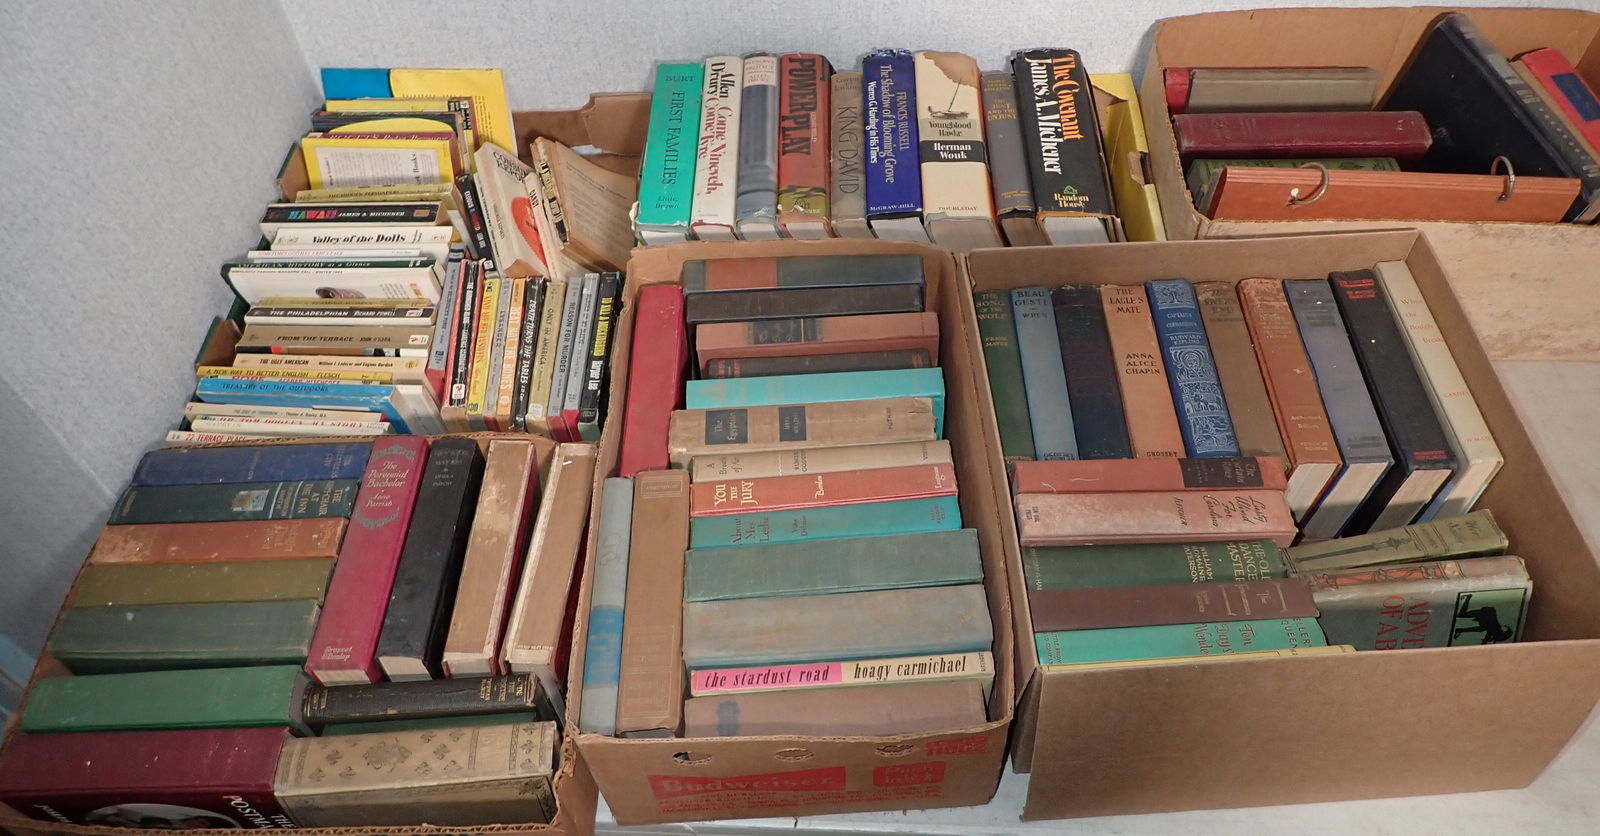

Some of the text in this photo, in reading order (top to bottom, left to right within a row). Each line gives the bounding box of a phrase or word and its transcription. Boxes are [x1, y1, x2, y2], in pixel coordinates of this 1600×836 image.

[707, 62, 726, 96] Drury
[719, 72, 735, 98] Allen
[782, 57, 818, 156] POWER PLAY
[1053, 53, 1083, 141] The Covenant
[698, 97, 719, 159] Come Tyre
[716, 106, 733, 142] Come
[838, 106, 859, 142] KING
[866, 80, 879, 164] Warren Harding Times
[879, 64, 897, 183] The Shadow of Blooming Grove
[896, 91, 909, 151] FRANCIS RUSSELL
[929, 121, 972, 130] Youngblood
[1025, 56, 1063, 174] James Michener
[663, 91, 685, 185] FIRST FAMILIES
[939, 129, 962, 137] Hawke
[934, 142, 971, 151] Herman
[940, 151, 967, 159] Wouk
[838, 149, 859, 194] DAVID
[1054, 193, 1089, 202] Random
[287, 209, 338, 219] HAWAII
[312, 234, 406, 244] Valley of the Dolls
[567, 302, 576, 328] REASON
[1116, 306, 1141, 314] MATE
[520, 299, 536, 384] DEATH TURNS THE TABLES
[540, 341, 549, 365] AMERICA
[559, 344, 569, 373] MURDER
[590, 360, 603, 379] Harper
[222, 383, 254, 391] TREASURY
[588, 380, 600, 390] Lee
[197, 433, 225, 443] TERRACE
[714, 418, 724, 434] The
[727, 411, 737, 442] Egyptian
[367, 469, 409, 480] Perennial
[382, 460, 398, 471] The
[332, 488, 344, 504] THE
[366, 478, 406, 488] Bachelor
[730, 485, 738, 499] THE
[297, 498, 309, 514] INN
[365, 499, 393, 508] Parrish
[1235, 495, 1255, 525] Wind
[1248, 495, 1267, 524] Lusty
[732, 517, 742, 544] About
[760, 516, 769, 543] Leslie
[1377, 595, 1405, 636] OF A
[1403, 597, 1433, 650] ADVE
[1192, 622, 1210, 656] Wonde
[705, 655, 967, 688] the stardust road hoagy carmichael
[661, 775, 834, 793] Budweiser
